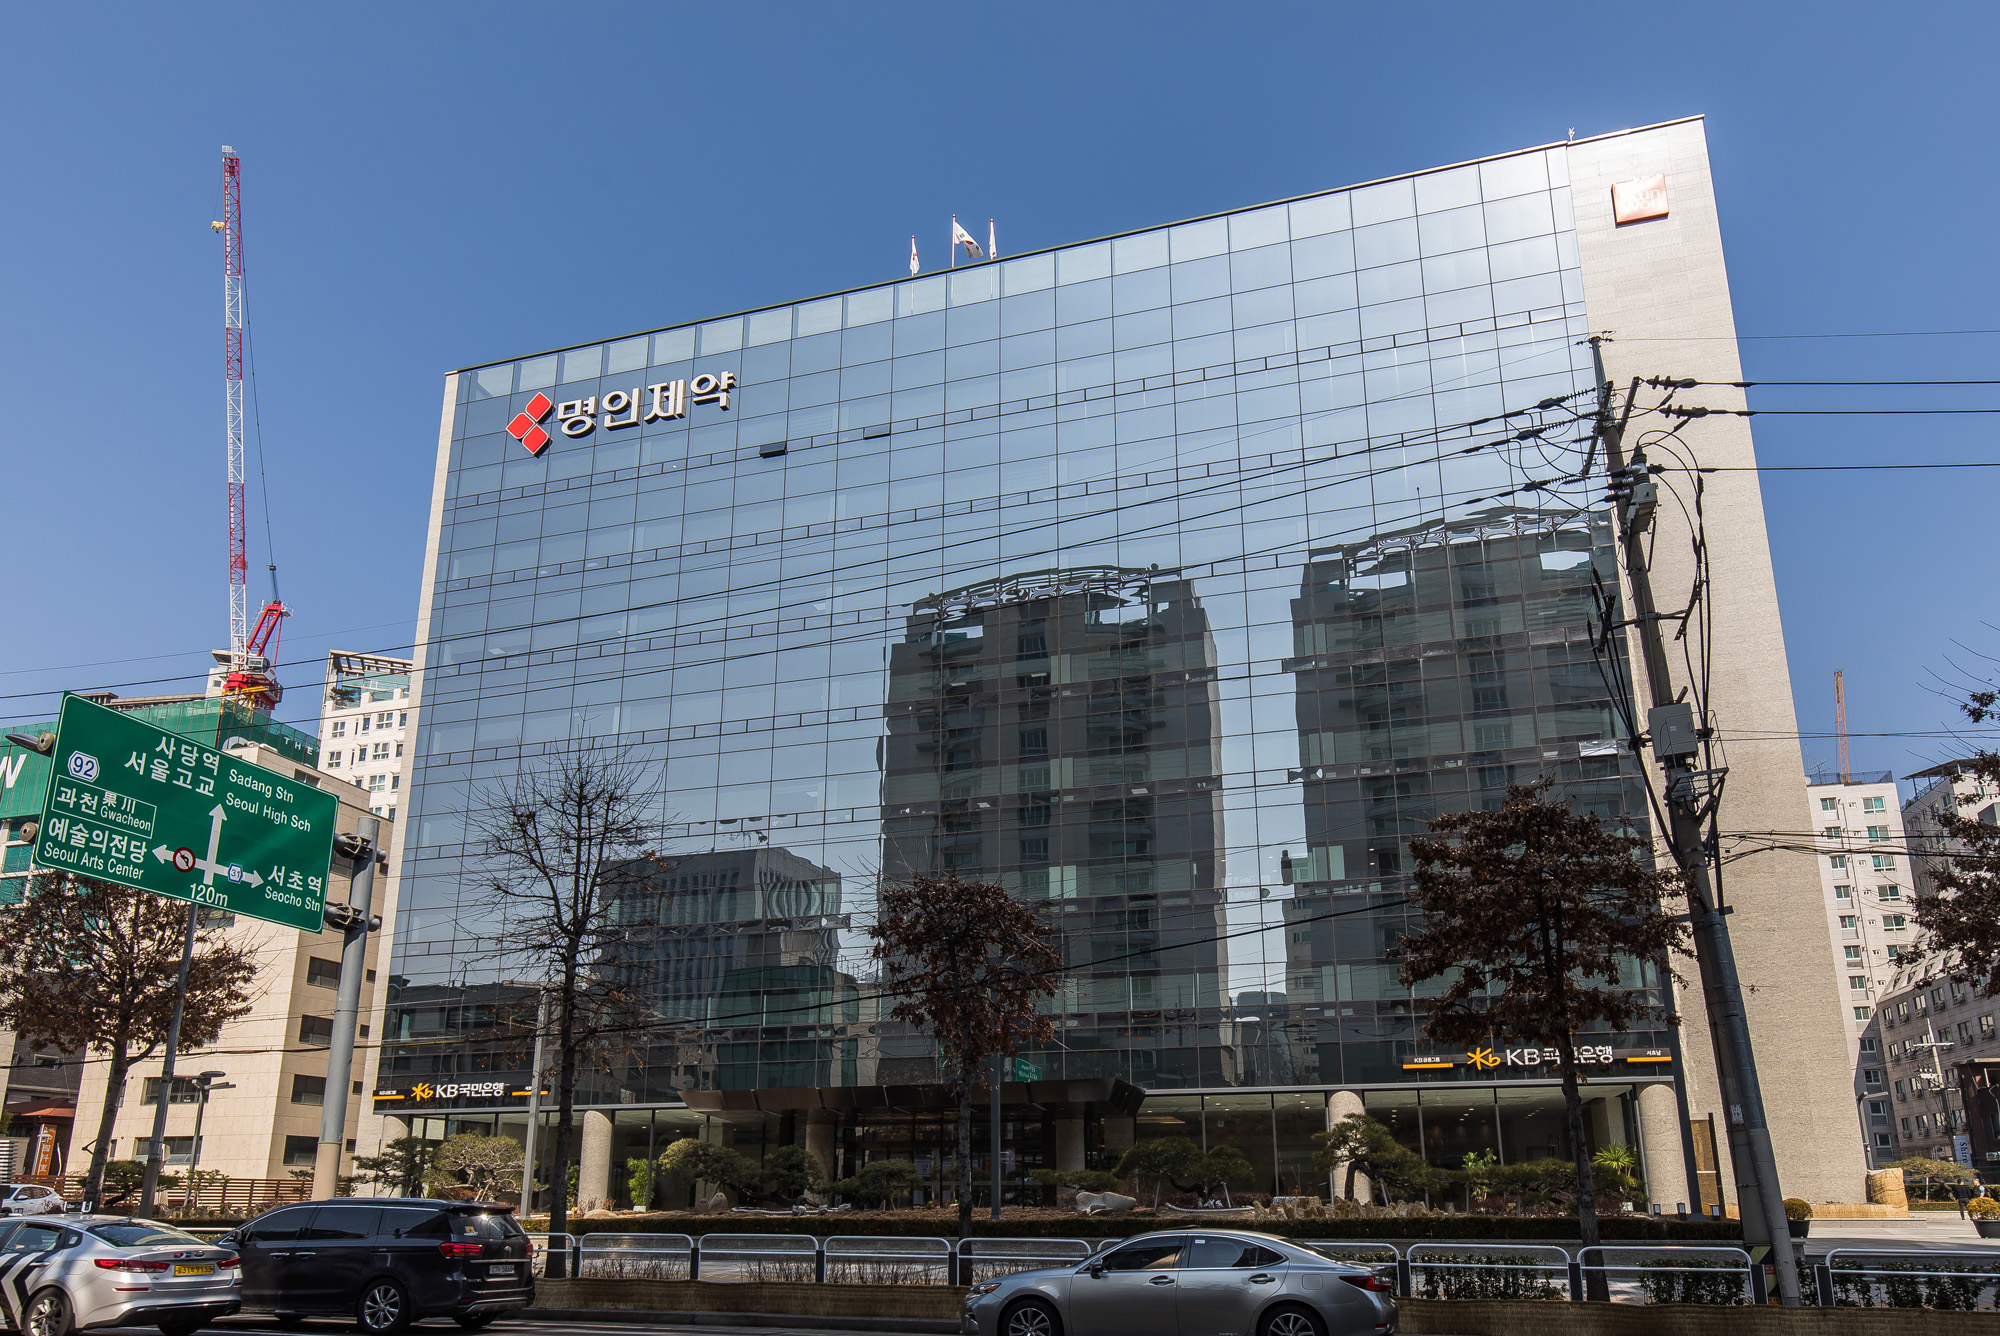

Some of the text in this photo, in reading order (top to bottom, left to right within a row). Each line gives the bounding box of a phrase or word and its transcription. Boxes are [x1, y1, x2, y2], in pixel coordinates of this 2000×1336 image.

[557, 370, 737, 439] 명인제약
[155, 736, 220, 776] 사당역
[284, 736, 313, 755] THE
[72, 756, 95, 778] 92
[124, 751, 215, 797] 서울고교
[57, 786, 98, 815] 과천
[229, 768, 294, 803] Sadang Stn
[100, 805, 151, 831] Gwacheon
[226, 792, 311, 832] Seoul High Sch
[48, 818, 147, 863] 예술의전당
[44, 842, 144, 880] Seoul Arts Center
[230, 868, 241, 879] 31
[190, 883, 228, 907] 120m
[267, 865, 322, 897] 서초역
[264, 886, 320, 912] Seocho Stn
[435, 1082, 505, 1098] KB국민은행
